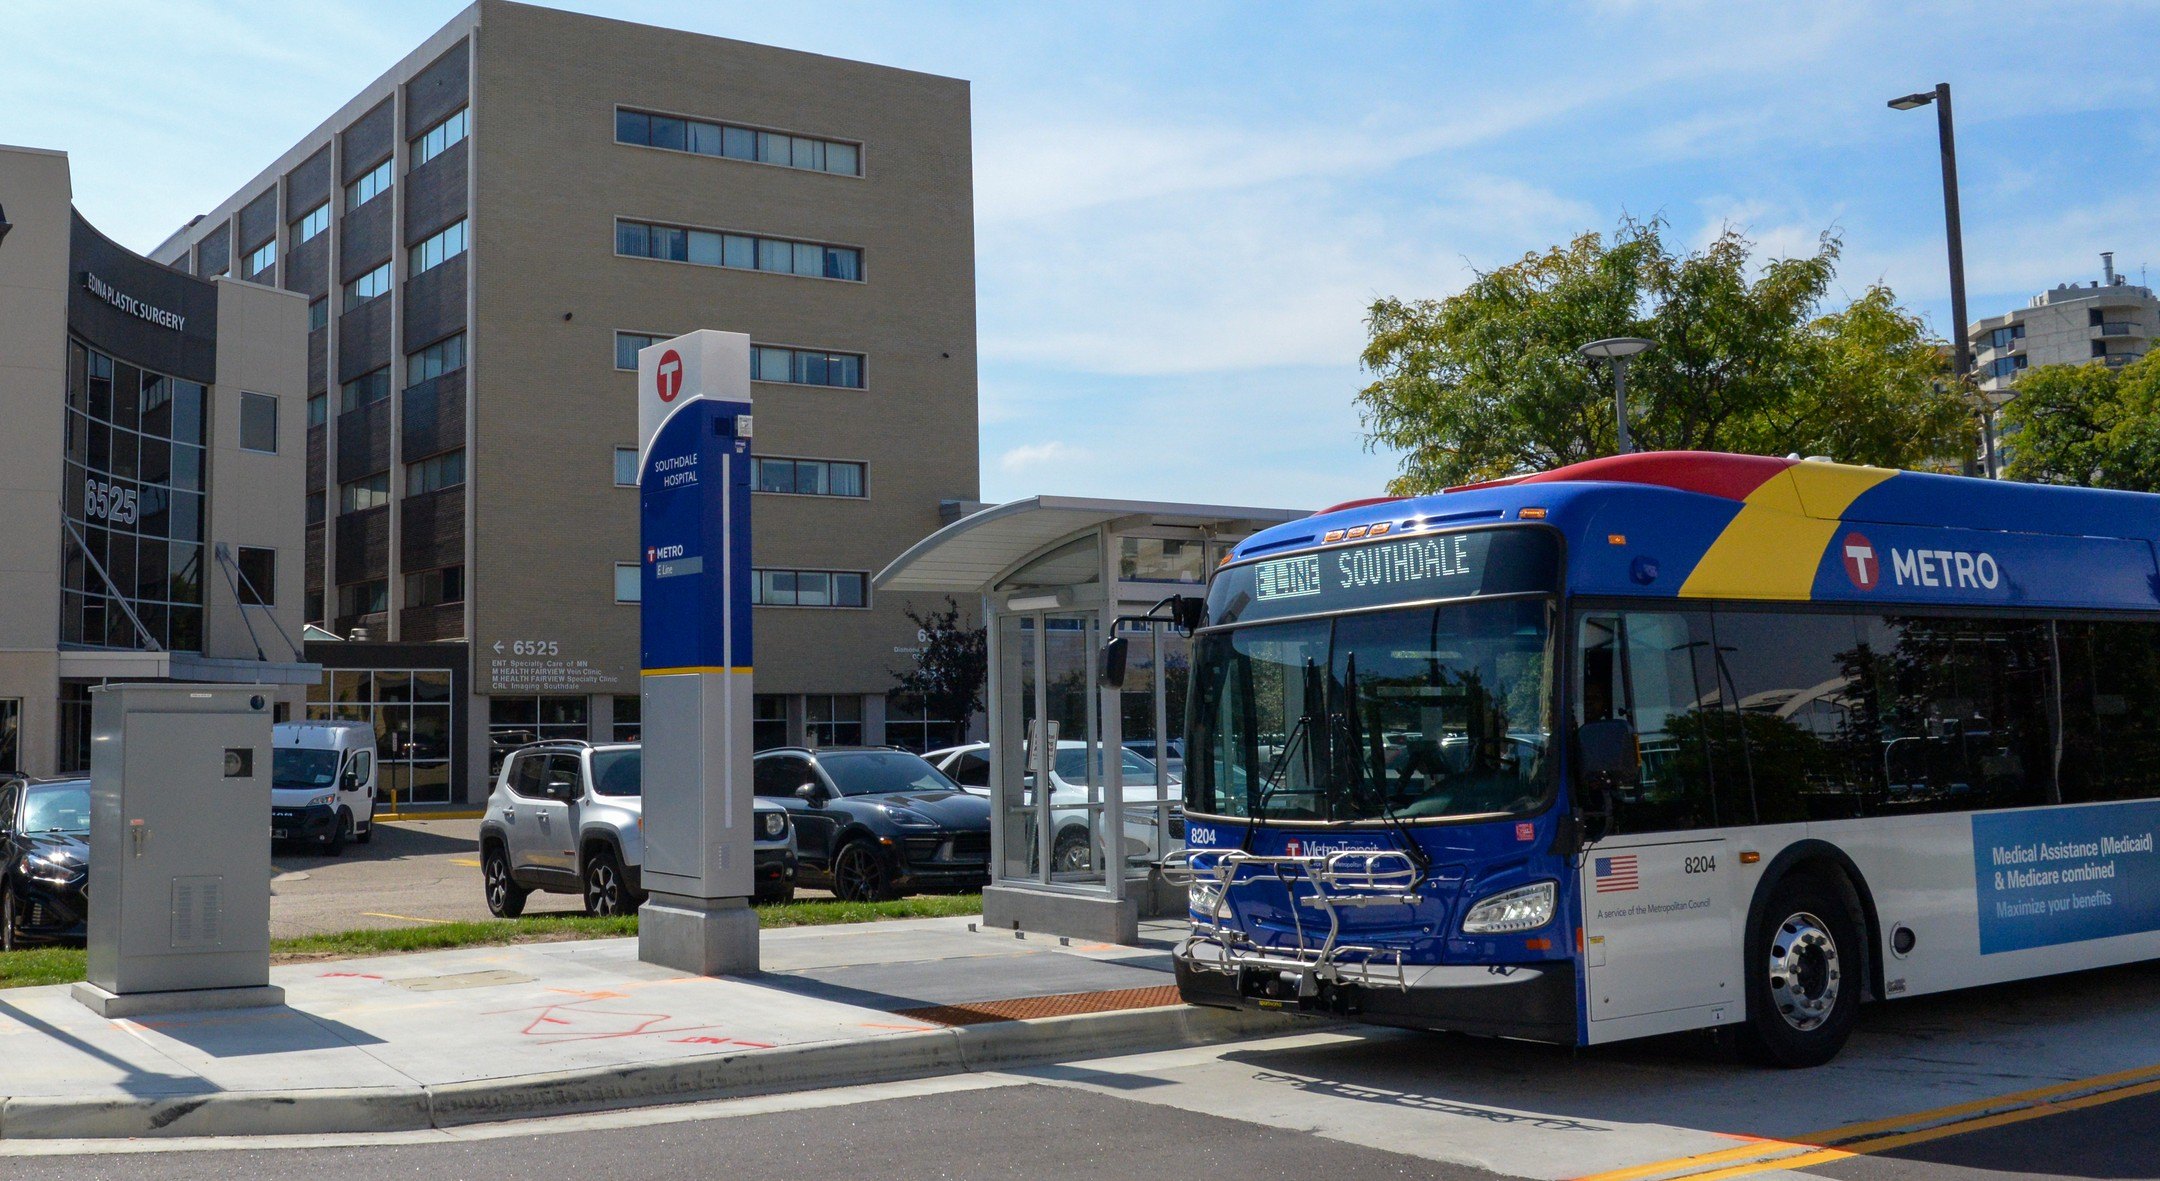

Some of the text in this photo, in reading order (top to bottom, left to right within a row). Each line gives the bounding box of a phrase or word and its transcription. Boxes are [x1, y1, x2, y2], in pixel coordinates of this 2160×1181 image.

[88, 272, 185, 331] EDINA PLASTIC SURGERY
[655, 453, 698, 473] SOUTHDALE
[664, 471, 698, 487] HOSPITAL
[85, 478, 137, 524] 6525
[656, 544, 683, 559] METRO
[657, 565, 673, 576] E Line
[1274, 559, 1319, 594] LINE
[1338, 535, 1470, 588] SOUTHDALE
[1891, 547, 1999, 589] METRO
[513, 640, 559, 656] 6525
[492, 667, 602, 675] M HEALTH FAIRVIEW Vein Clinic
[510, 660, 544, 668] Specialty
[511, 682, 540, 691] Imaging
[543, 682, 580, 690] Southdale
[567, 675, 598, 684] Specialty
[1191, 827, 1216, 844] 8204
[1993, 833, 2153, 865] Medical Assistance (Medicaid)
[1685, 855, 1716, 874] 8204
[1995, 860, 2115, 890] & Medicare combined
[1598, 898, 1711, 919] A service of the Metropolitan Council
[1996, 889, 2112, 918] Maximize your benefits
